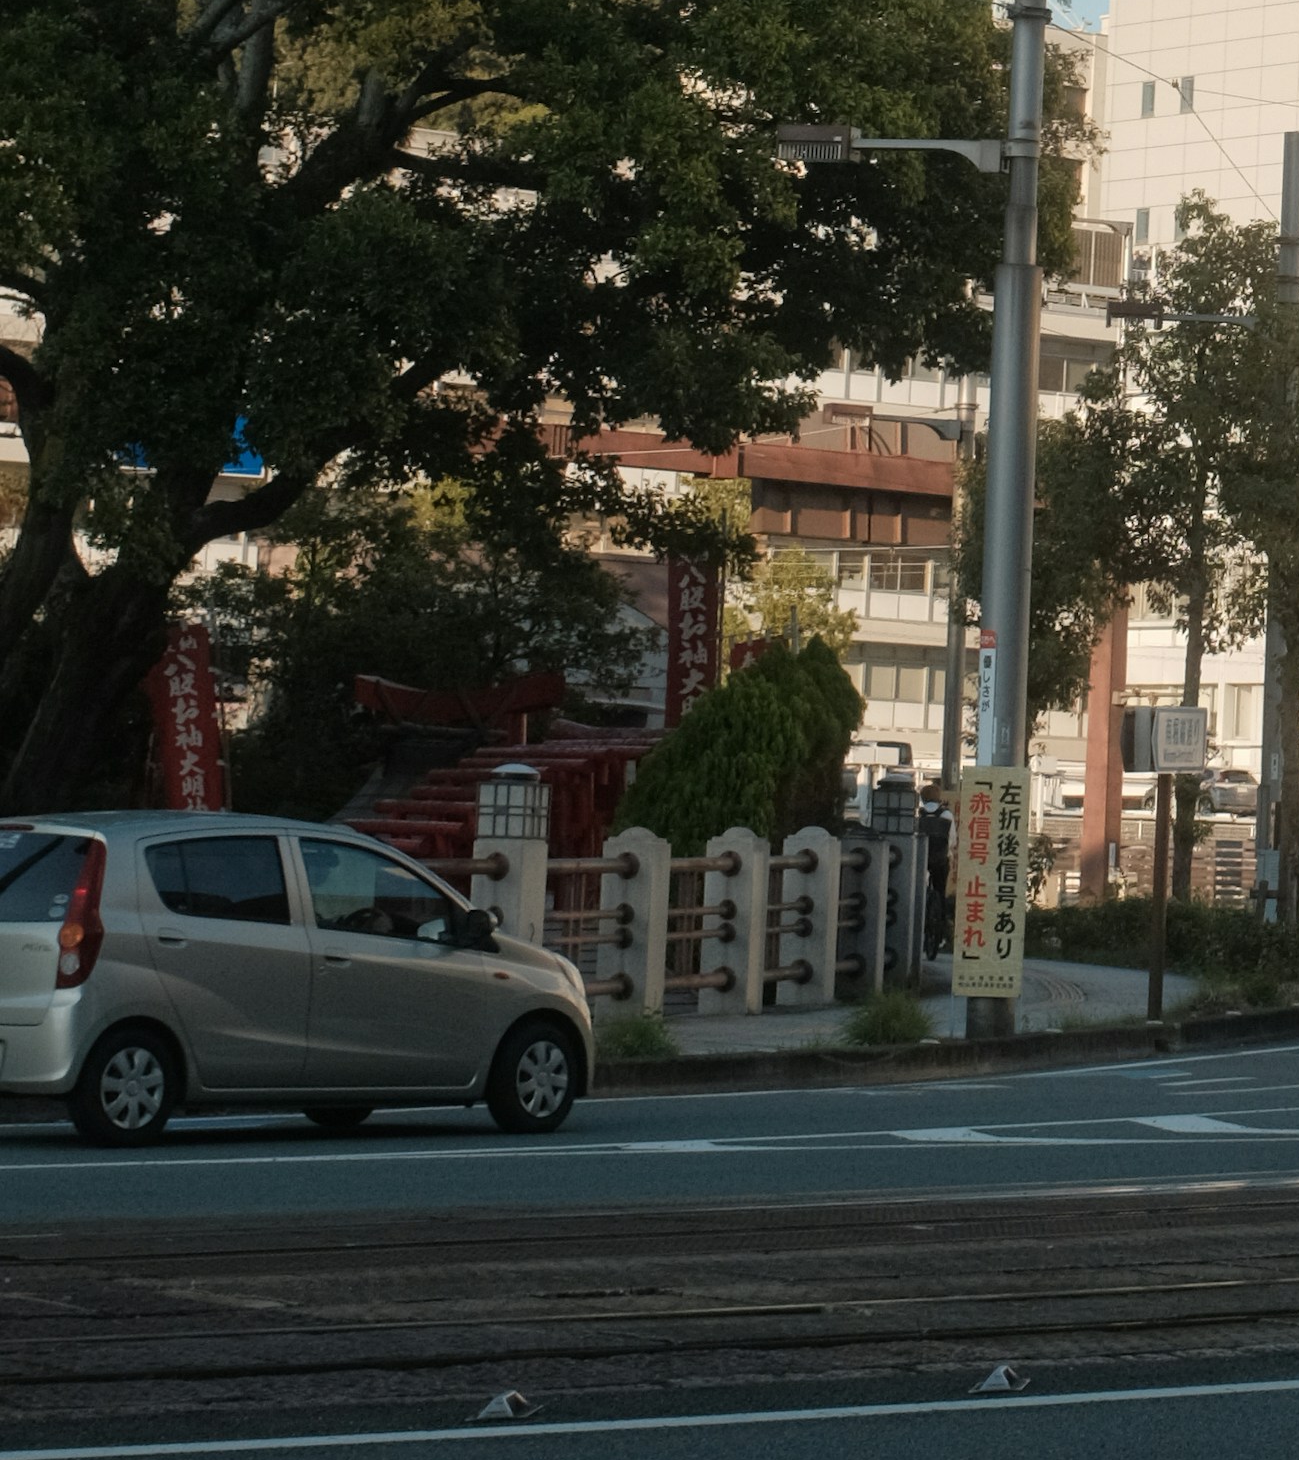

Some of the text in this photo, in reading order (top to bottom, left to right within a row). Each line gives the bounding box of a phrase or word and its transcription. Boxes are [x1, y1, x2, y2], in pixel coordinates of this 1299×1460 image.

[993, 780, 1022, 961] 左折後信号あり
